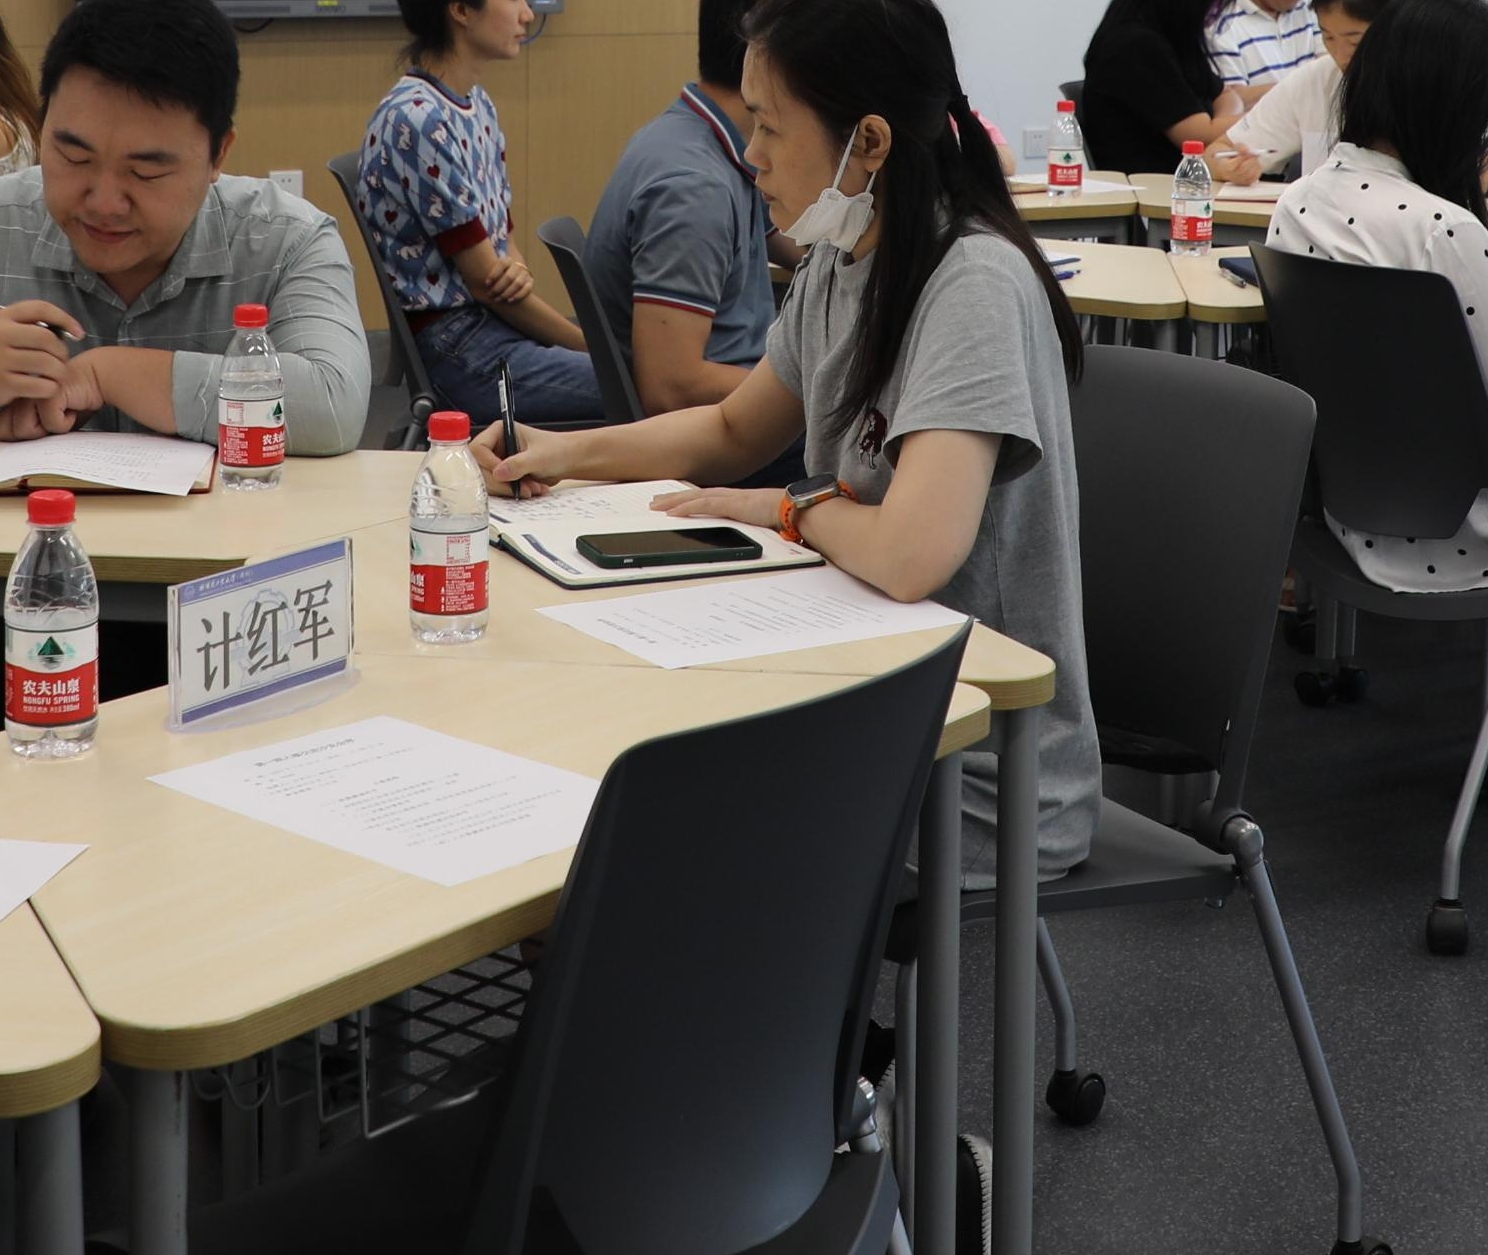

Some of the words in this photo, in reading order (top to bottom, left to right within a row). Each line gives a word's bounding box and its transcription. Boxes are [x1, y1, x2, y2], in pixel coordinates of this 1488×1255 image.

[196, 579, 335, 692] 计红军
[22, 677, 80, 696] 农夫山泉
[23, 696, 52, 705] NONGFU
[53, 694, 80, 704] SPRING
